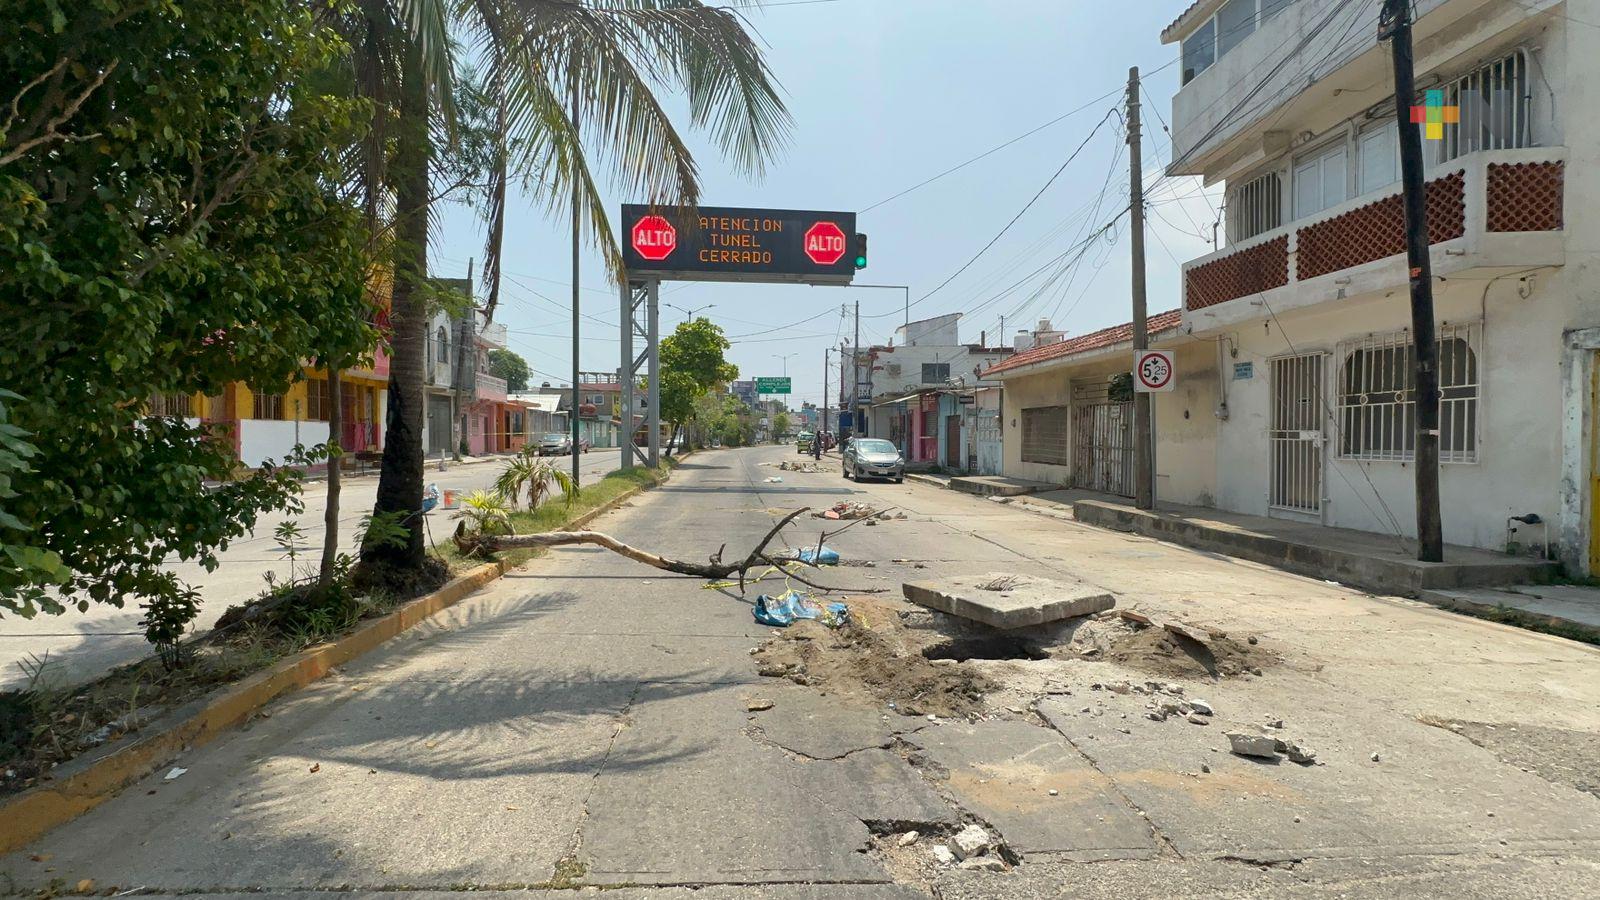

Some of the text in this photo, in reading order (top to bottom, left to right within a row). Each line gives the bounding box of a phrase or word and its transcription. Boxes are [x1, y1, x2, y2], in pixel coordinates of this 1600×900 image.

[699, 217, 782, 230] ATENCION
[637, 229, 672, 246] ALTO
[710, 234, 760, 247] TUNEL
[808, 234, 843, 251] ALTO
[700, 249, 771, 263] CERRADO
[1144, 363, 1167, 378] 5 25
